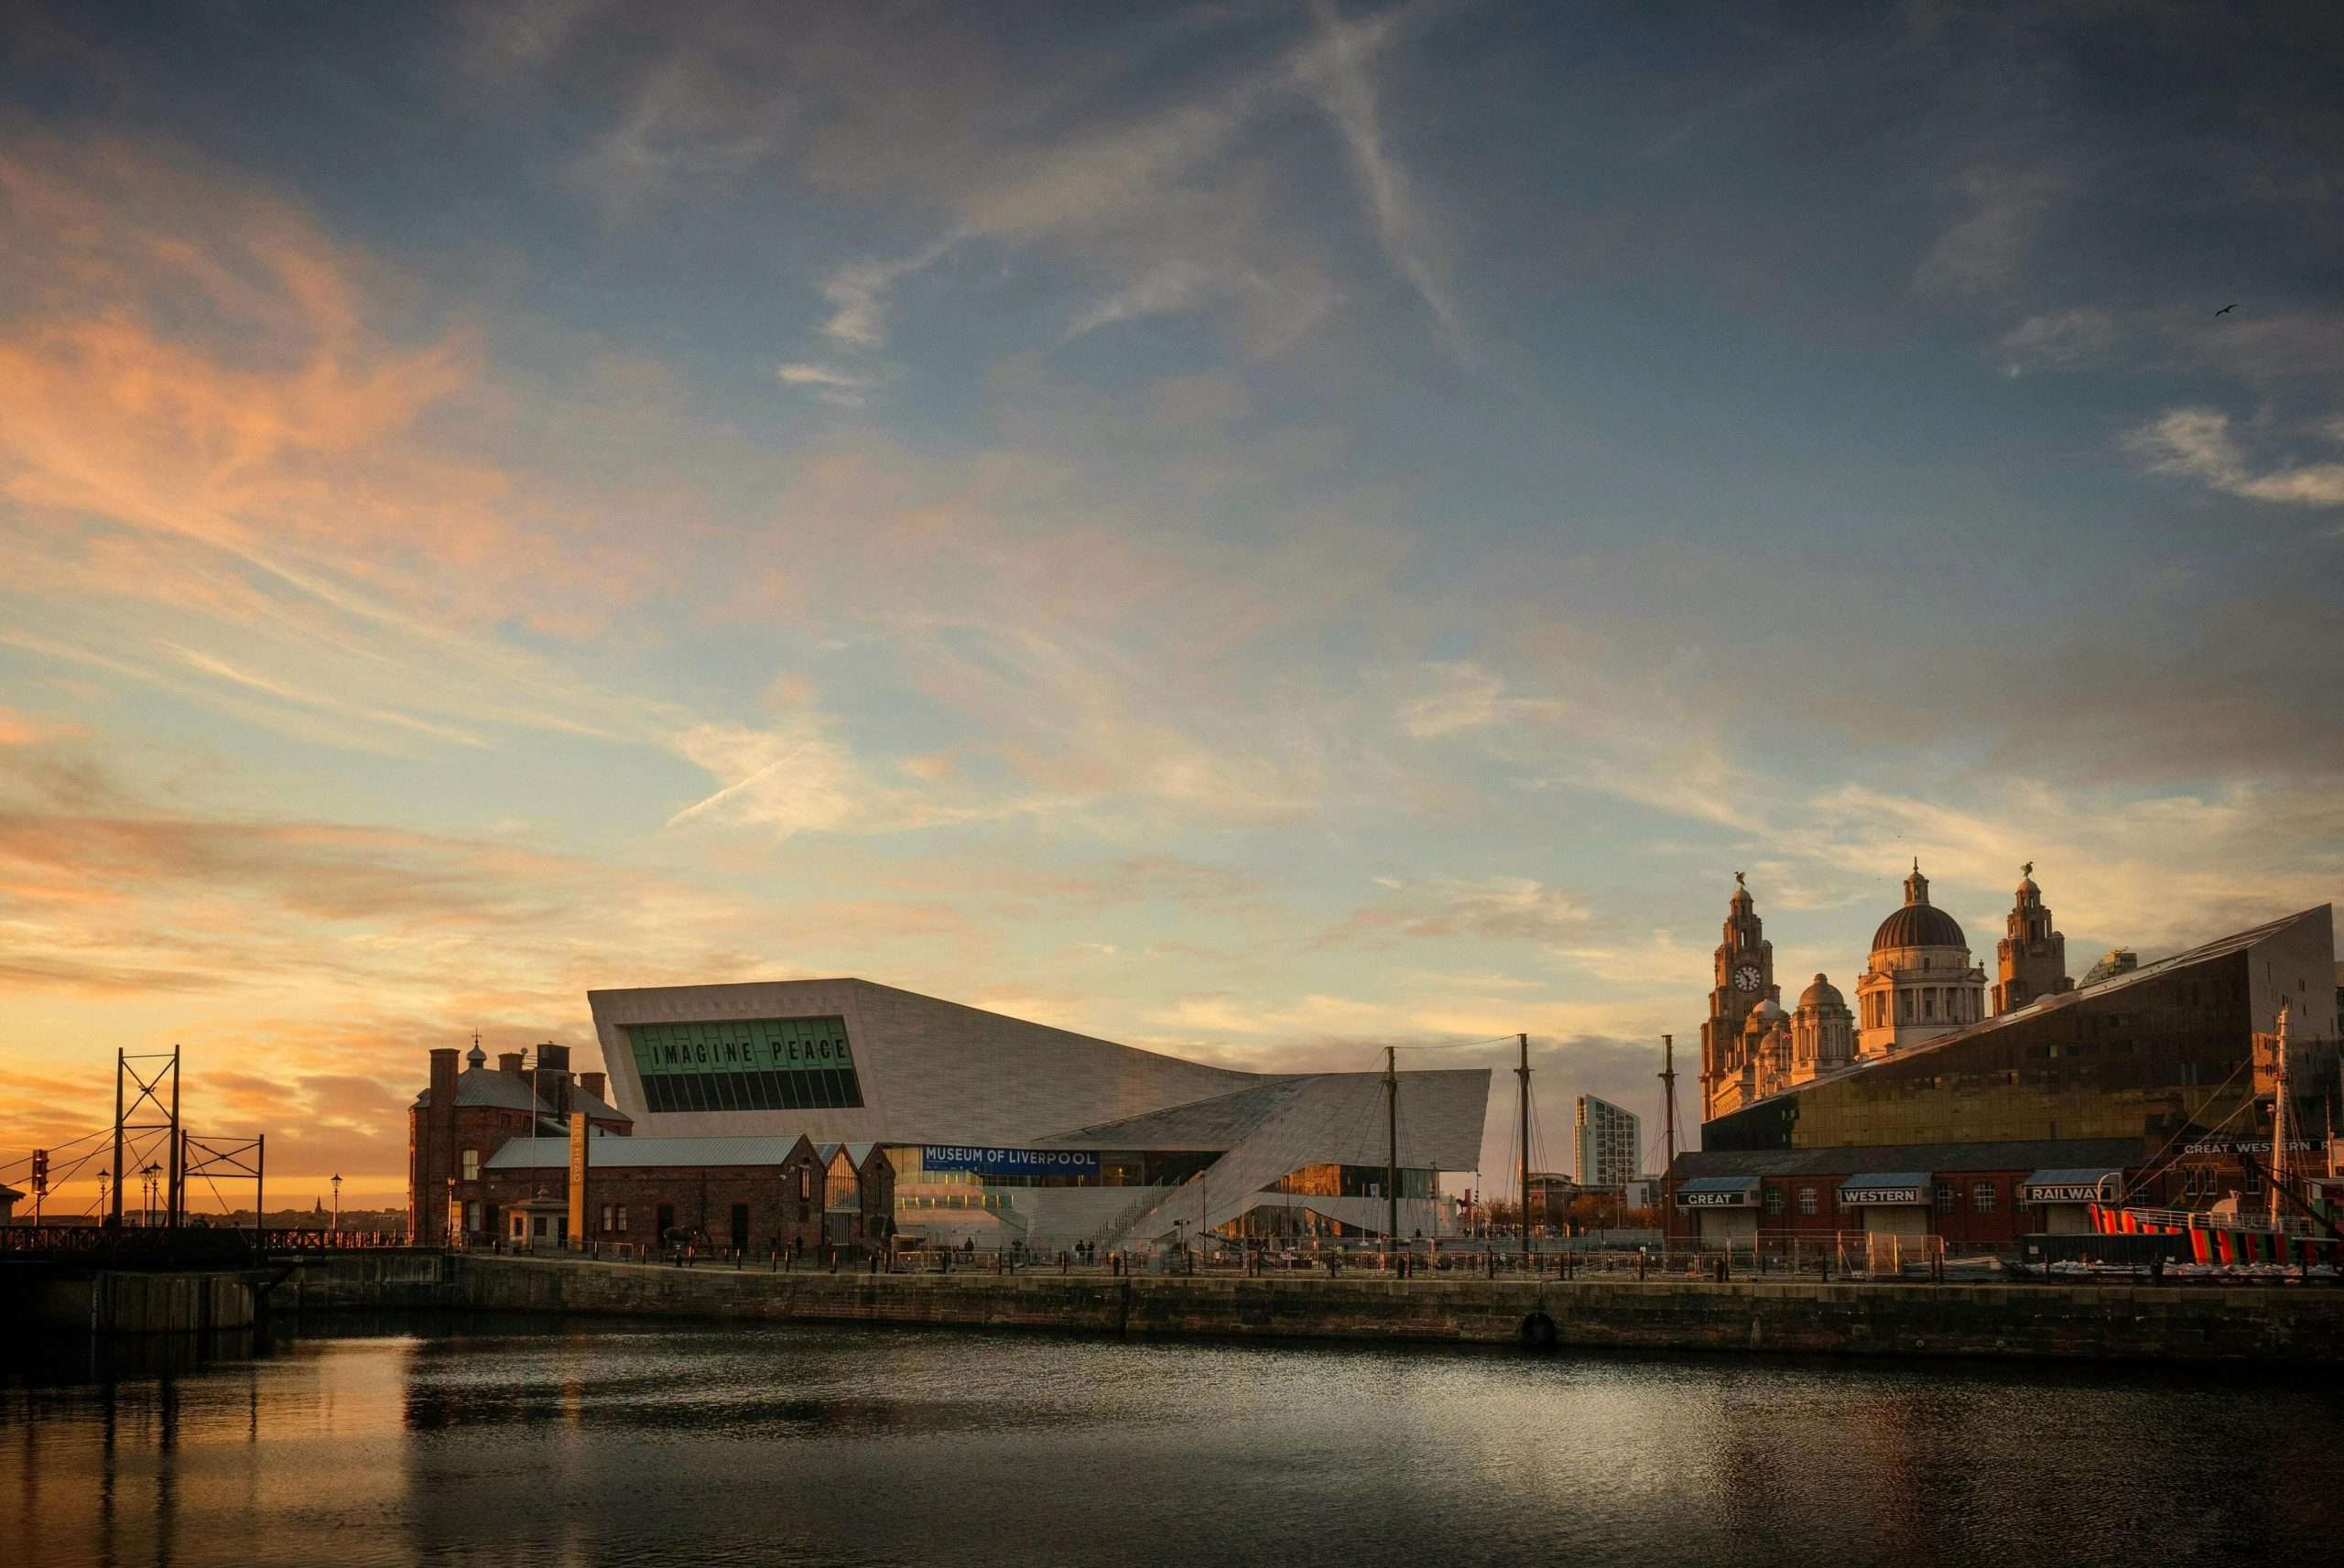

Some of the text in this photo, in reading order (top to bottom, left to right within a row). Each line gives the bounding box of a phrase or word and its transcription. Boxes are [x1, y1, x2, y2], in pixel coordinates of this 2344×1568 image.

[653, 1039, 846, 1065] IMAGINE PEACE
[926, 1146, 1096, 1165] MUSEUM OF LIVERPOOL
[2184, 1143, 2230, 1154] GREAT
[2236, 1141, 2310, 1153] WESERN
[573, 1148, 581, 1183] HEAD
[1687, 1194, 1731, 1206] GREAT
[1844, 1190, 1915, 1203] WESTERN
